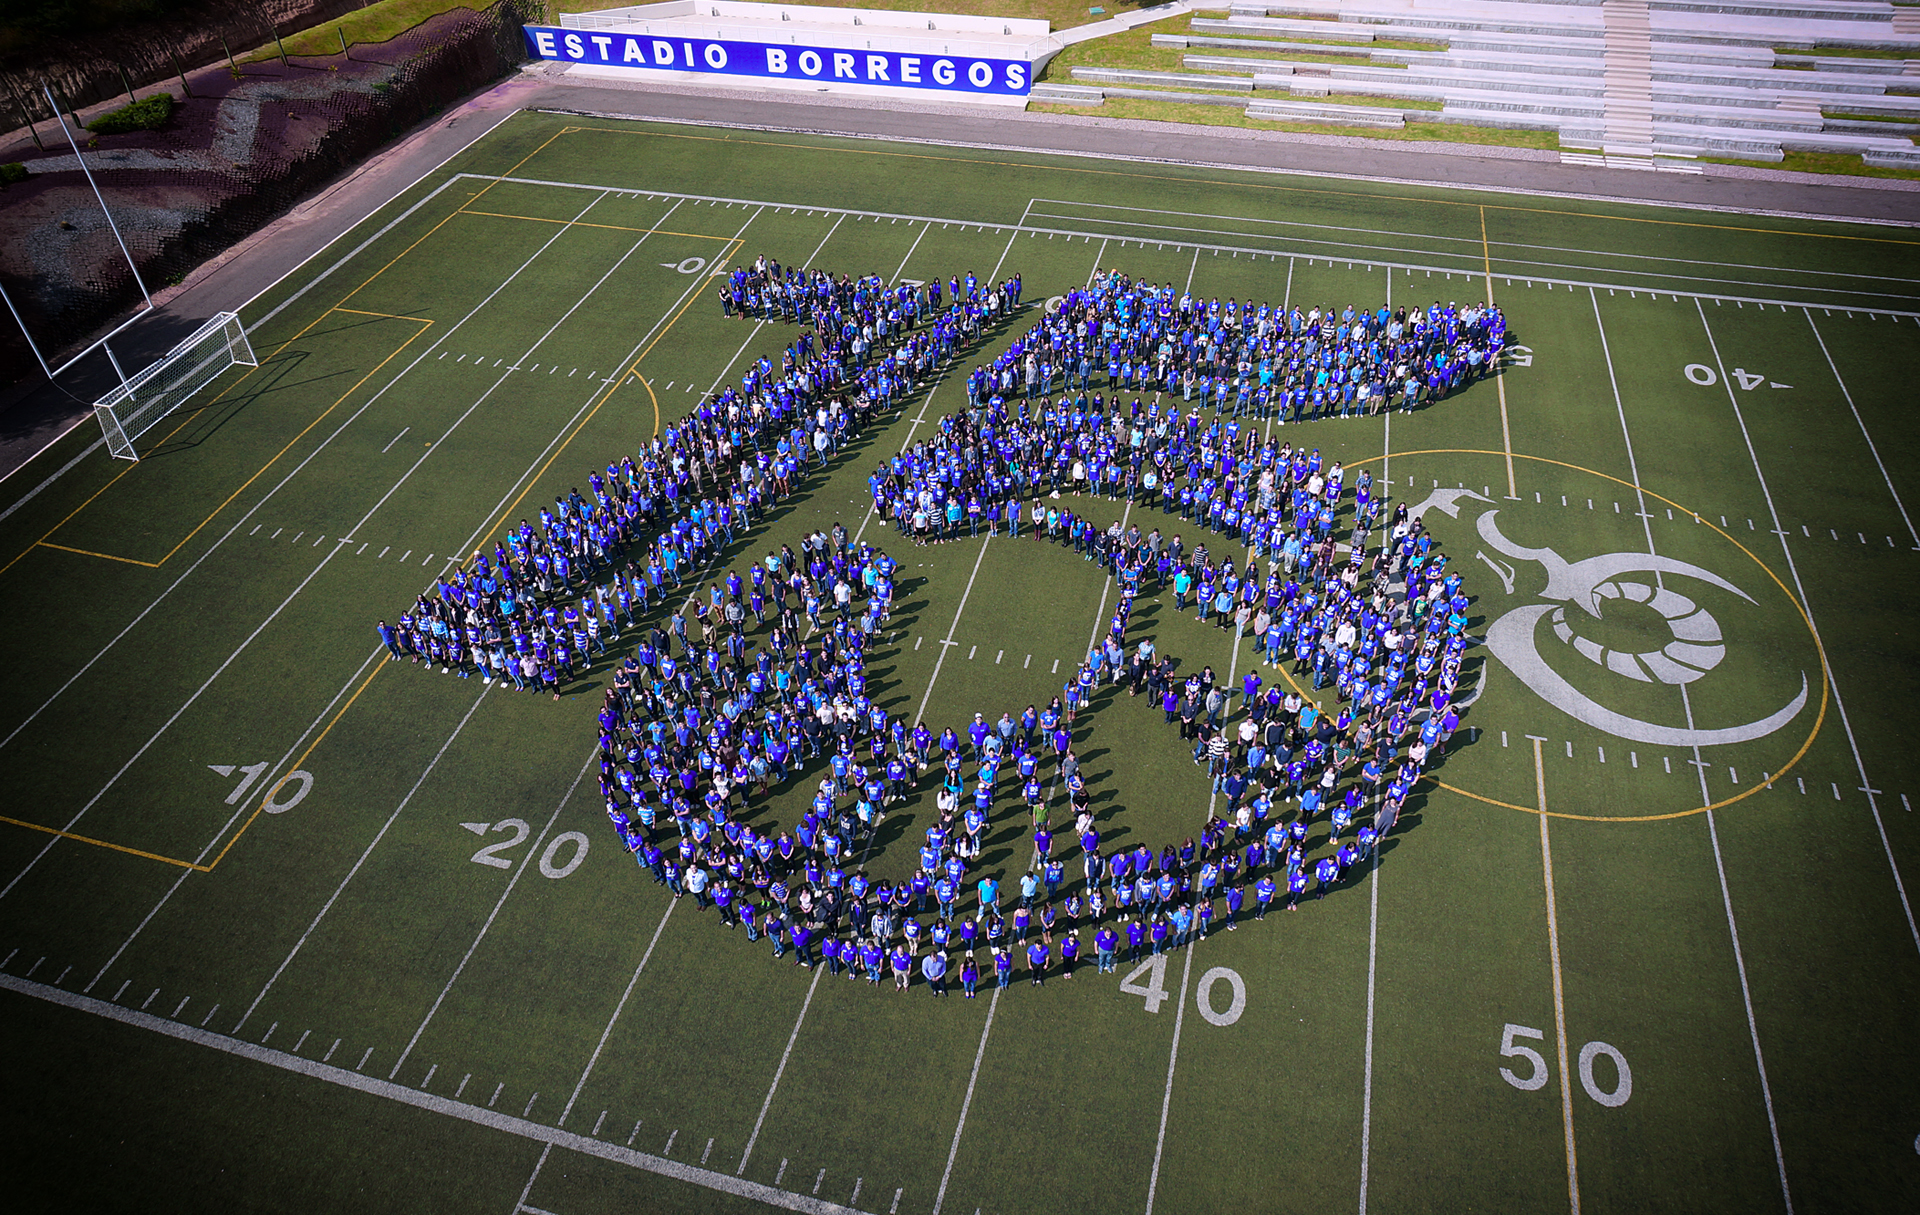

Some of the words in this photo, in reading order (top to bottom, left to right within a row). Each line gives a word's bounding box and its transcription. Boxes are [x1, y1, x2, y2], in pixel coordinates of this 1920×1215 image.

[535, 31, 729, 69] ESTADIO
[766, 48, 1026, 90] BORREGOS
[224, 761, 314, 814] 10
[470, 818, 590, 879] 20
[1119, 954, 1246, 1027] 40
[1498, 1022, 1633, 1108] 50
